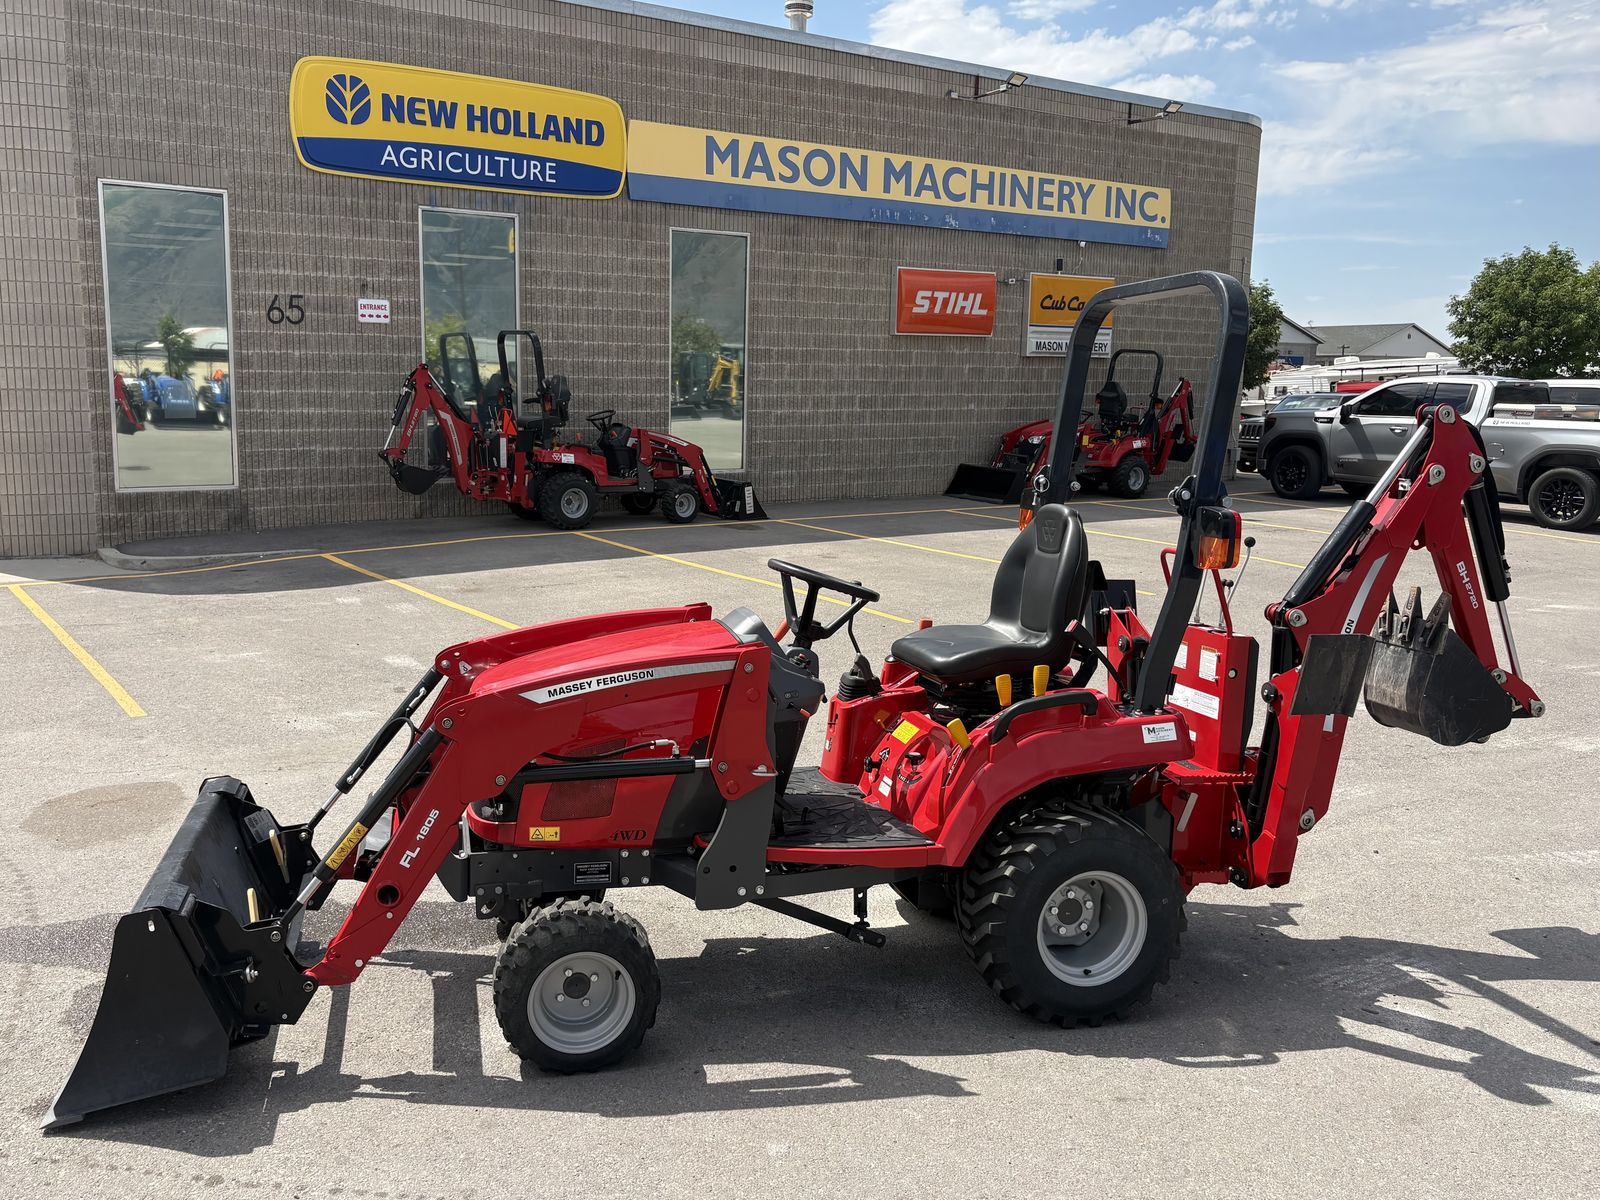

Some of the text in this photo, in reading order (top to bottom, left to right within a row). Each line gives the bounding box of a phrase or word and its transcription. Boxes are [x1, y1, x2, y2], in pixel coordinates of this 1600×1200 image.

[381, 93, 605, 147] NEW HOLLAND
[380, 145, 557, 183] AGRICULTURE
[704, 135, 1168, 225] MASON MACHINERY INC.
[267, 295, 305, 324] 65
[359, 303, 388, 311] ENTRANCE
[912, 290, 988, 315] STIHL
[1040, 294, 1067, 310] Cub
[1035, 341, 1063, 351] MASON
[1456, 561, 1479, 609] BH2720
[547, 670, 654, 698] MASSEY FERGUSON
[399, 809, 439, 868] FL 1805
[609, 829, 647, 841] 4WD
